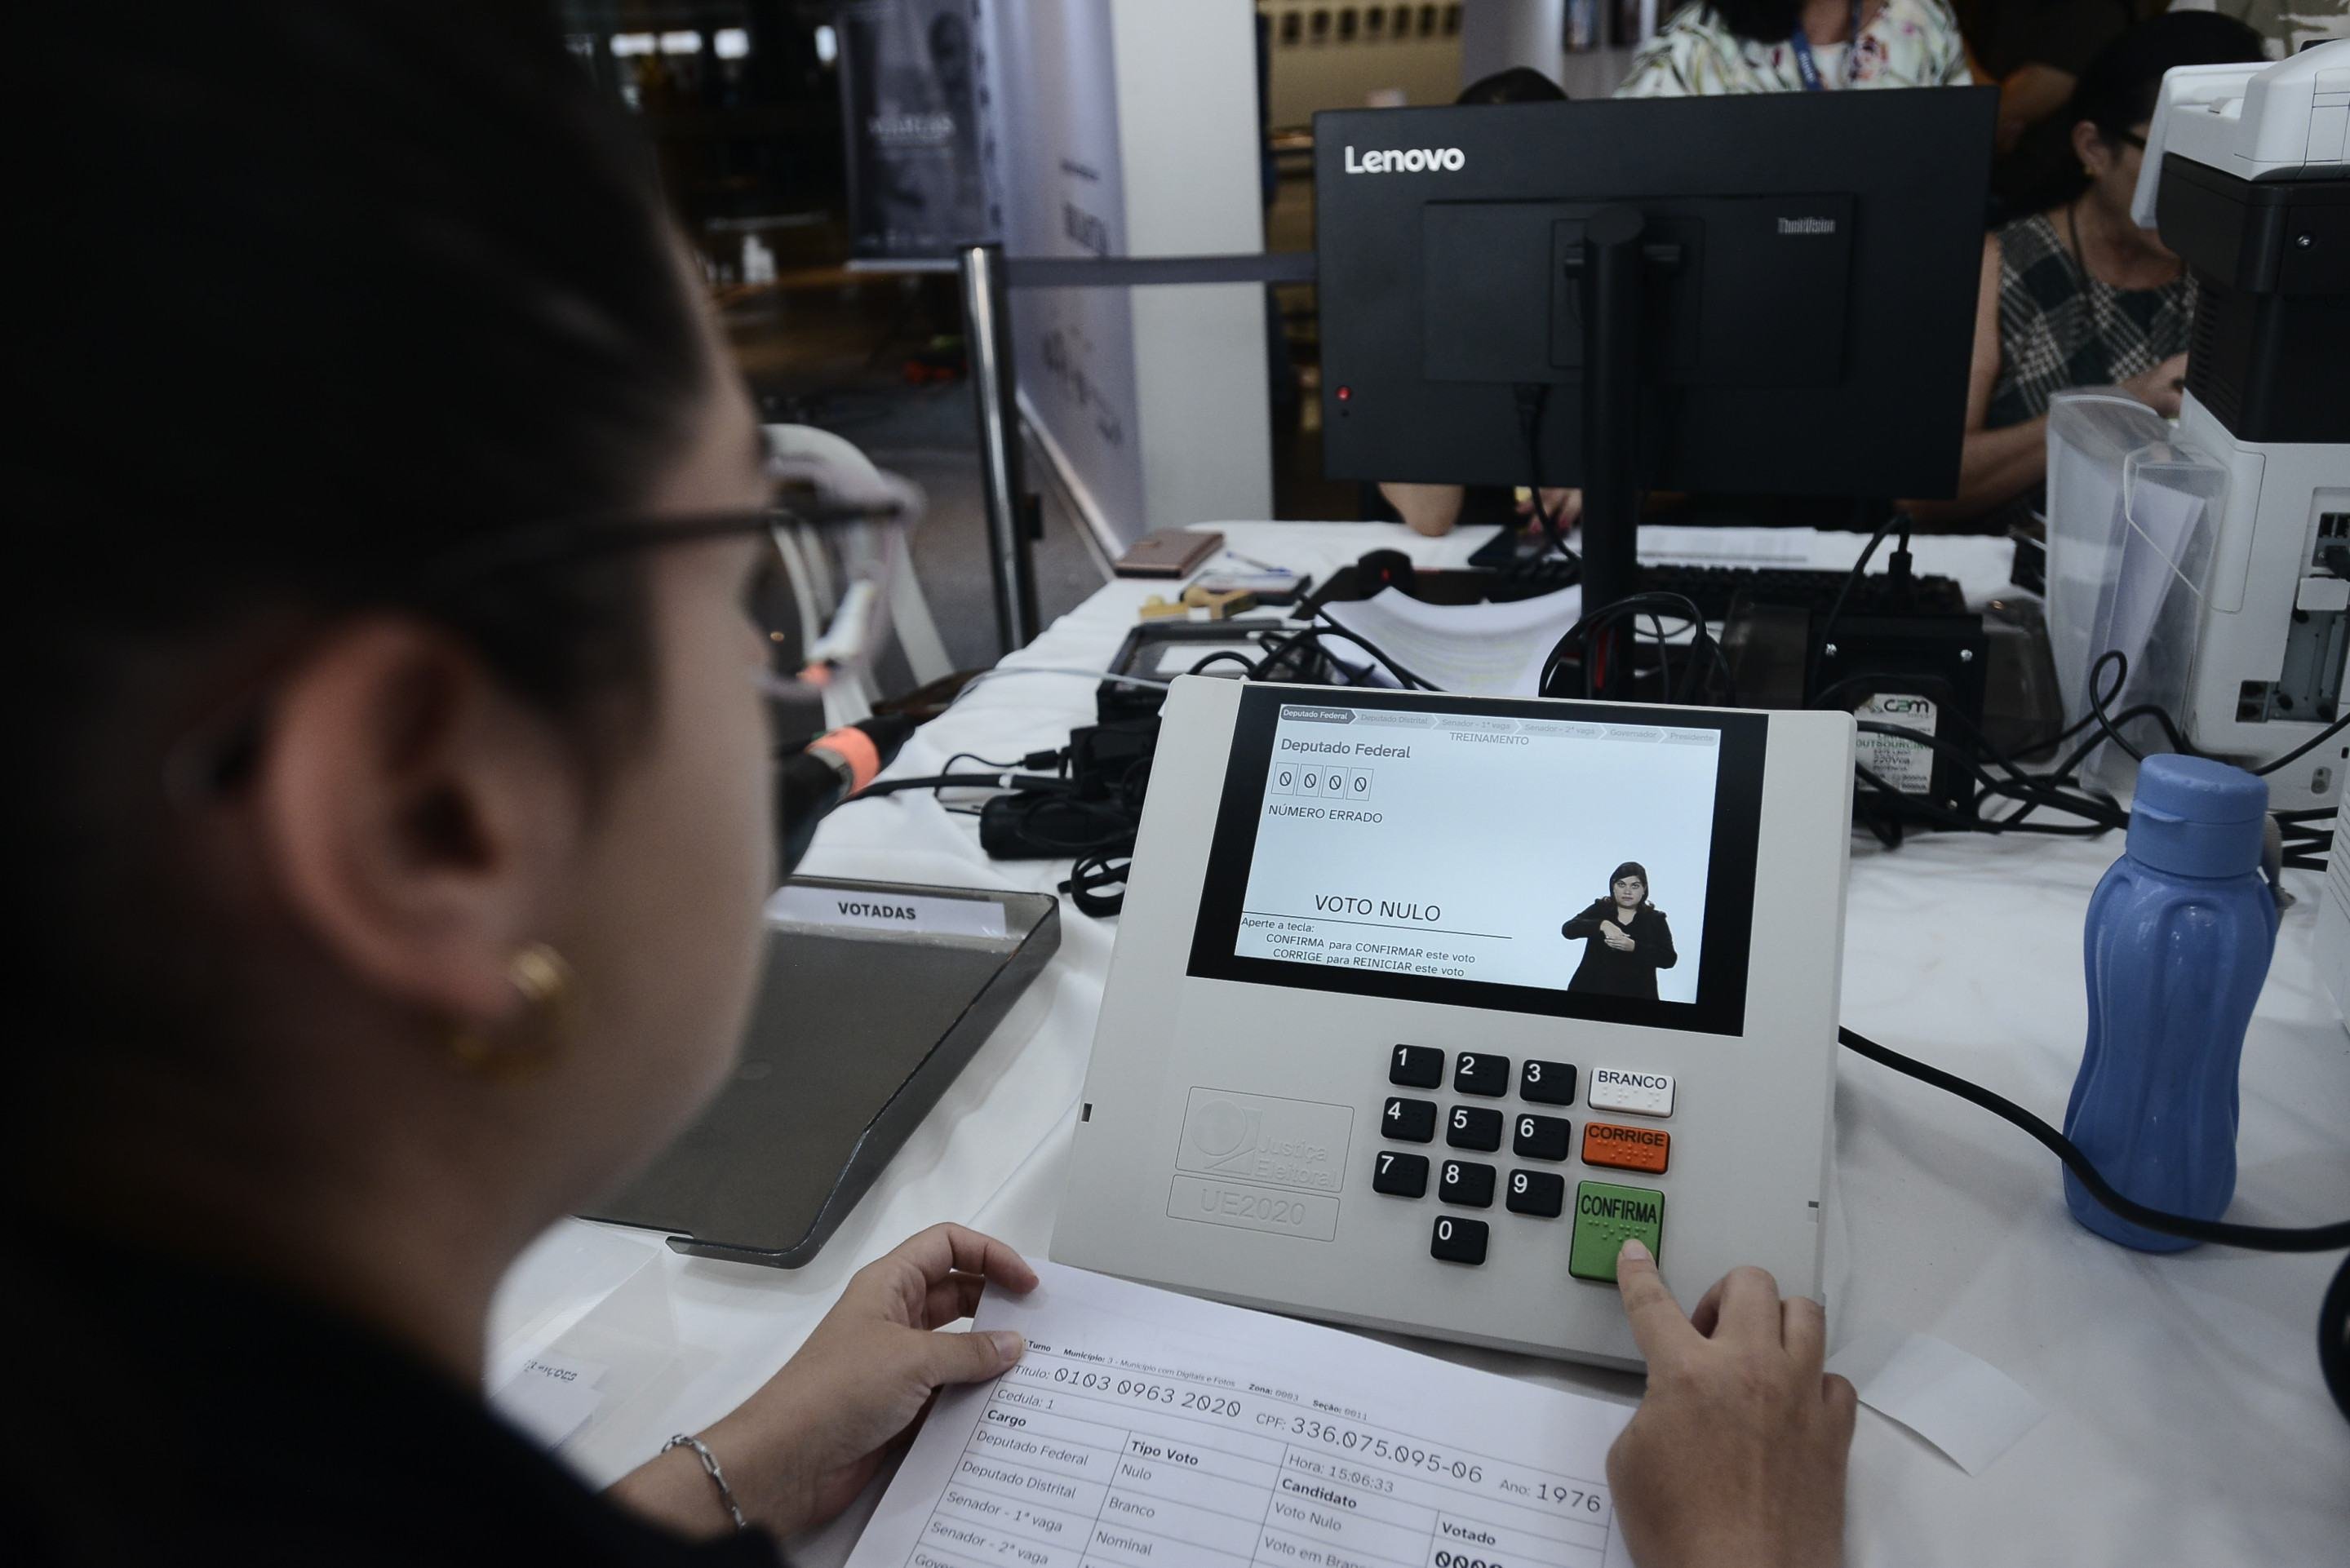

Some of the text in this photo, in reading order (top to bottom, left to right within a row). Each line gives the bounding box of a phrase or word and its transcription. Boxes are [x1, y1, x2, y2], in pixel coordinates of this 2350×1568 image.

[1344, 145, 1465, 175] Lenovo
[1283, 709, 1348, 720] Deputado Federal
[1360, 714, 1428, 725] Deputado Distrital
[1442, 719, 1474, 728] Senador
[1492, 723, 1510, 732] vaga
[1449, 732, 1530, 746] TREINAMENTO
[1524, 724, 1558, 733] Senador
[1576, 729, 1595, 737] vaga
[1610, 729, 1657, 738] Governador
[1670, 733, 1714, 742] Presidente
[1281, 738, 1411, 759] Deputado Federal
[1268, 804, 1383, 823] NÚMERO ERRADO
[837, 901, 916, 920] VOTADAS
[1315, 894, 1441, 922] VOTO NULO
[1241, 917, 1275, 931] Aperte
[1287, 922, 1315, 933] tecla:
[1266, 933, 1476, 964] CONFIRMA para CONFIRMAR este voto
[1273, 948, 1465, 977] CORRIGE para REINICIAR este voto
[1397, 1048, 1408, 1066] 1
[1460, 1056, 1475, 1075] 2
[1527, 1063, 1542, 1083] 3
[1598, 1069, 1668, 1091] BRANCO
[1387, 1102, 1402, 1121] 4
[1453, 1110, 1468, 1130] 5
[1520, 1118, 1535, 1138] 6
[1588, 1124, 1665, 1148] CORRIGE
[1257, 1135, 1330, 1163] Justiça
[1254, 1159, 1338, 1188] Eleitoral
[1380, 1155, 1395, 1175] 7
[1445, 1164, 1460, 1185] 8
[1513, 1173, 1528, 1194] 9
[1200, 1187, 1307, 1227] UE2020
[1580, 1194, 1659, 1225] CONFIRMA
[1438, 1220, 1453, 1242] 0
[1029, 1340, 1052, 1352] Turno
[1063, 1348, 1106, 1363] Município:
[1120, 1359, 1156, 1372] Município
[1157, 1366, 1175, 1375] com
[1248, 1384, 1274, 1395] Zona:
[1313, 1399, 1342, 1414] Seção:
[997, 1389, 1054, 1410] Cedula: 1
[987, 1409, 1026, 1428] Cargo
[976, 1429, 1089, 1467] Deputado Federal
[1014, 1364, 1601, 1513] Título: 0103 0963 2020 CPF: 336.075.095-06 Ano: 1976
[1132, 1440, 1199, 1467] Tipo Voto
[961, 1460, 1077, 1499] Deputado Distrital
[1120, 1464, 1152, 1481] Nulo
[1288, 1454, 1394, 1494] Hora: 15:06:33
[1282, 1477, 1358, 1510] Candidato
[947, 1490, 1002, 1517] Senador
[1032, 1516, 1063, 1534] vaga
[1108, 1496, 1156, 1519] Branco
[1275, 1500, 1342, 1532] Voto Nulo
[930, 1521, 987, 1548] Senador
[1017, 1546, 1049, 1566] vaga
[1095, 1530, 1153, 1557] Nominal
[1441, 1521, 1496, 1546] Votado
[1265, 1535, 1296, 1556] Voto
[1299, 1549, 1322, 1564] em
